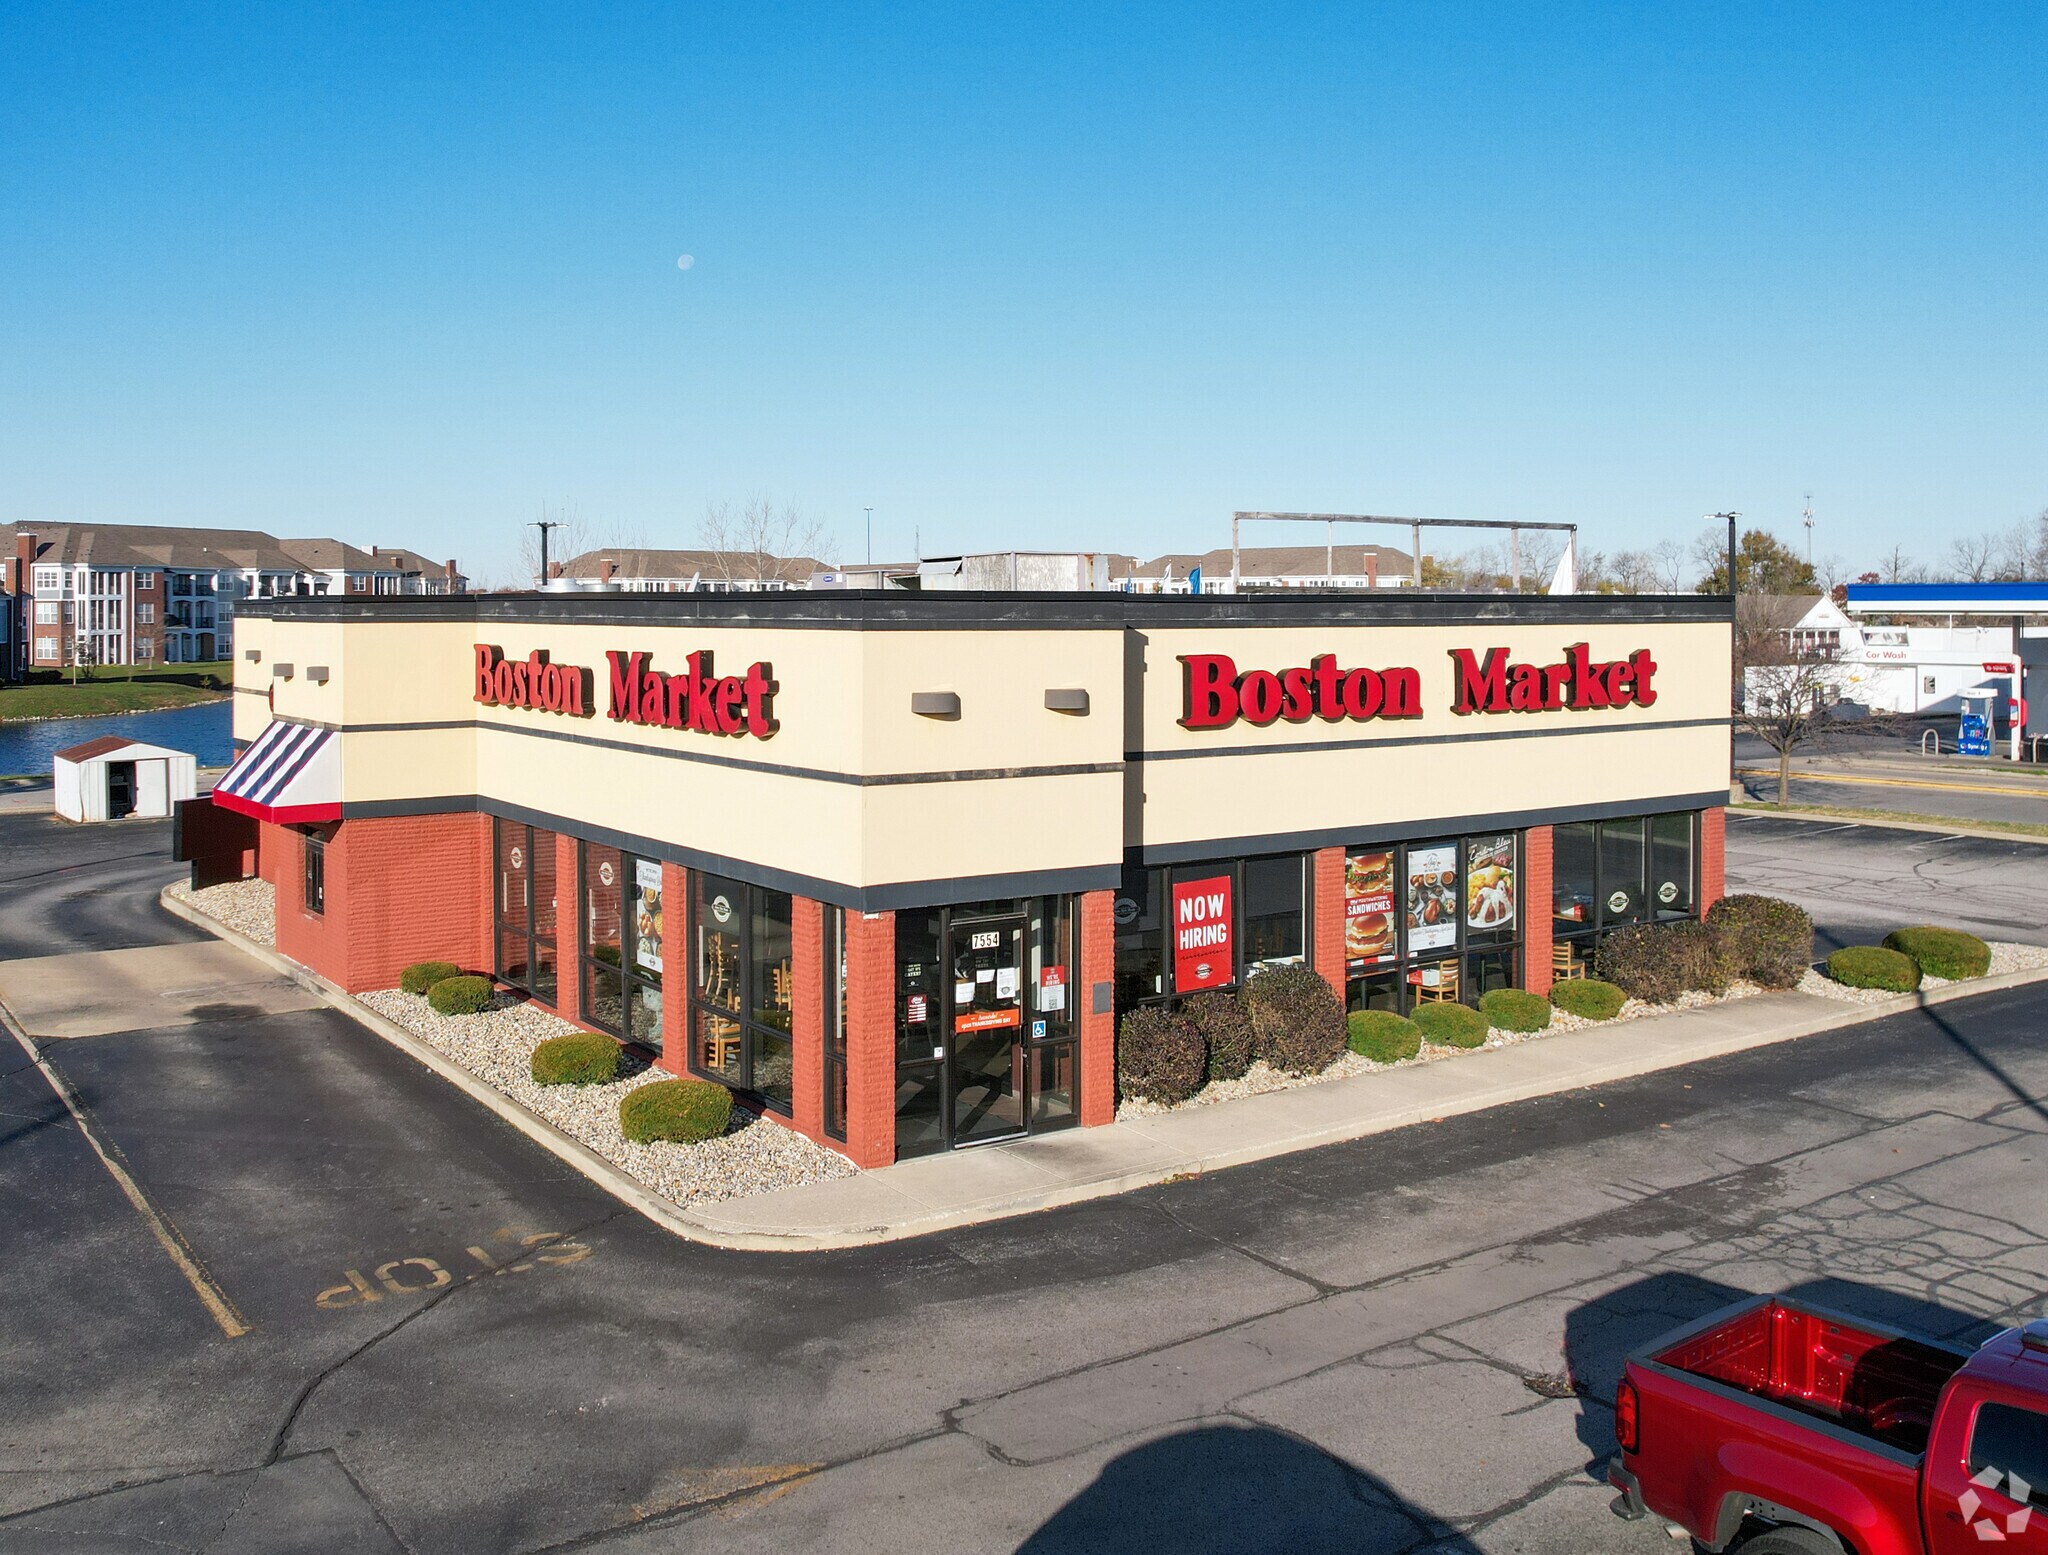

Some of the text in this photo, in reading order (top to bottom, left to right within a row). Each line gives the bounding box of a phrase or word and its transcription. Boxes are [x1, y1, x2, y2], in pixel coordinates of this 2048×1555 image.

[1865, 650, 1907, 659] Car Wash
[473, 643, 778, 738] Boston Market
[1177, 642, 1657, 731] Boston Market
[1967, 743, 1988, 751] Synegy
[1179, 892, 1225, 924] NOW
[1347, 900, 1391, 915] SANDWICHES
[973, 933, 998, 948] 7554
[1179, 922, 1227, 951] HIRING
